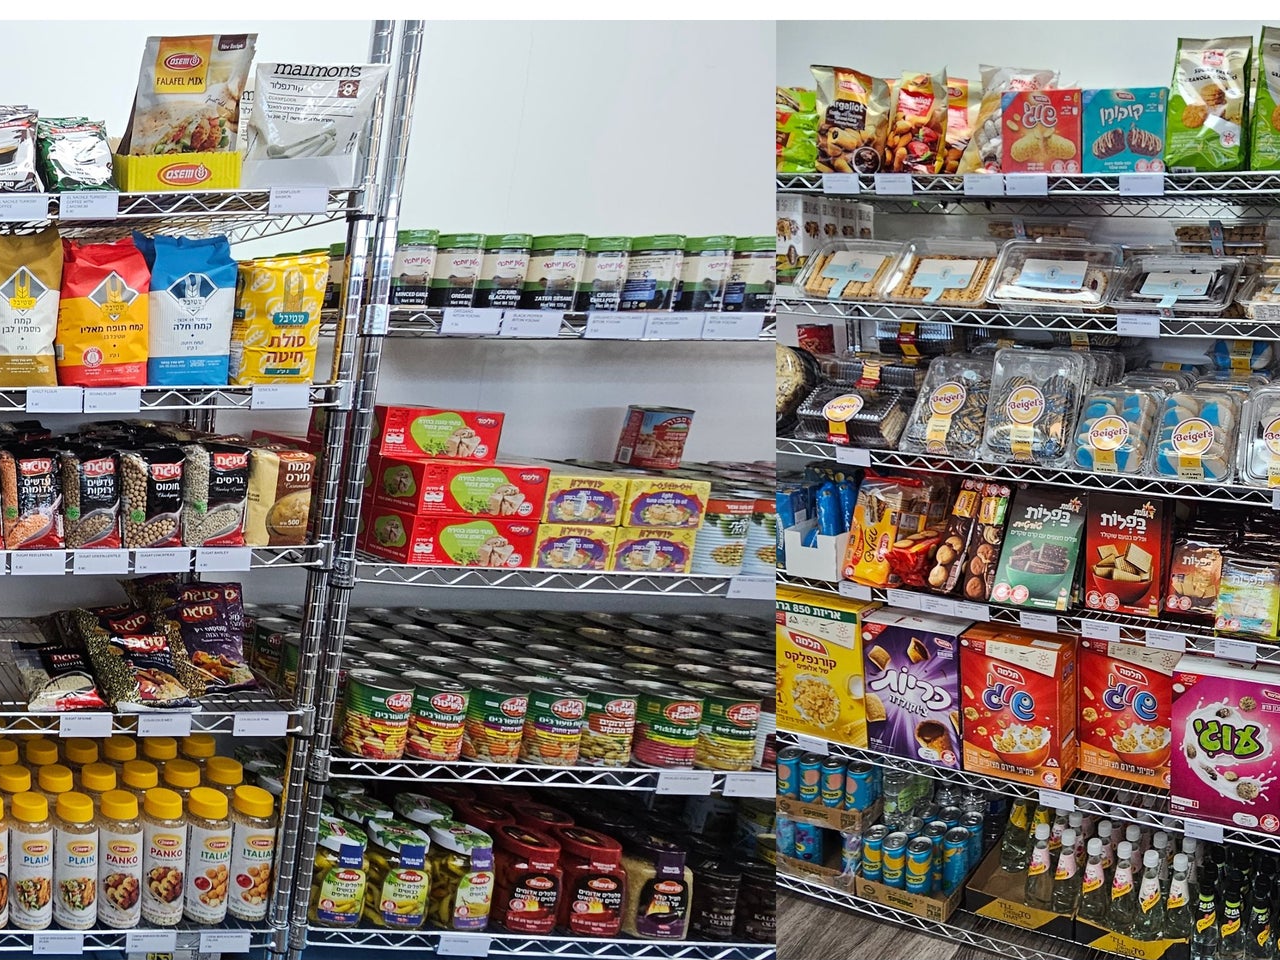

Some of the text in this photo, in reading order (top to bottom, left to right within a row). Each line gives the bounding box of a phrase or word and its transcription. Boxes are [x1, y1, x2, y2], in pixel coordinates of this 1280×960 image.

[156, 75, 204, 88] FALAFEL MIX
[14, 318, 32, 326] קמח
[276, 313, 308, 323] שטיבל
[80, 323, 144, 335] קמח תופח מאליו
[173, 322, 212, 331] קמח חלה
[269, 334, 306, 350] סולת
[266, 351, 304, 364] חיטה
[1089, 426, 1128, 440] Beigel's
[155, 482, 180, 491] חומוס
[784, 650, 837, 668] קורנפלקס
[150, 846, 183, 858] PANKO
[23, 855, 50, 865] PLAIN
[106, 854, 138, 865] PANKO
